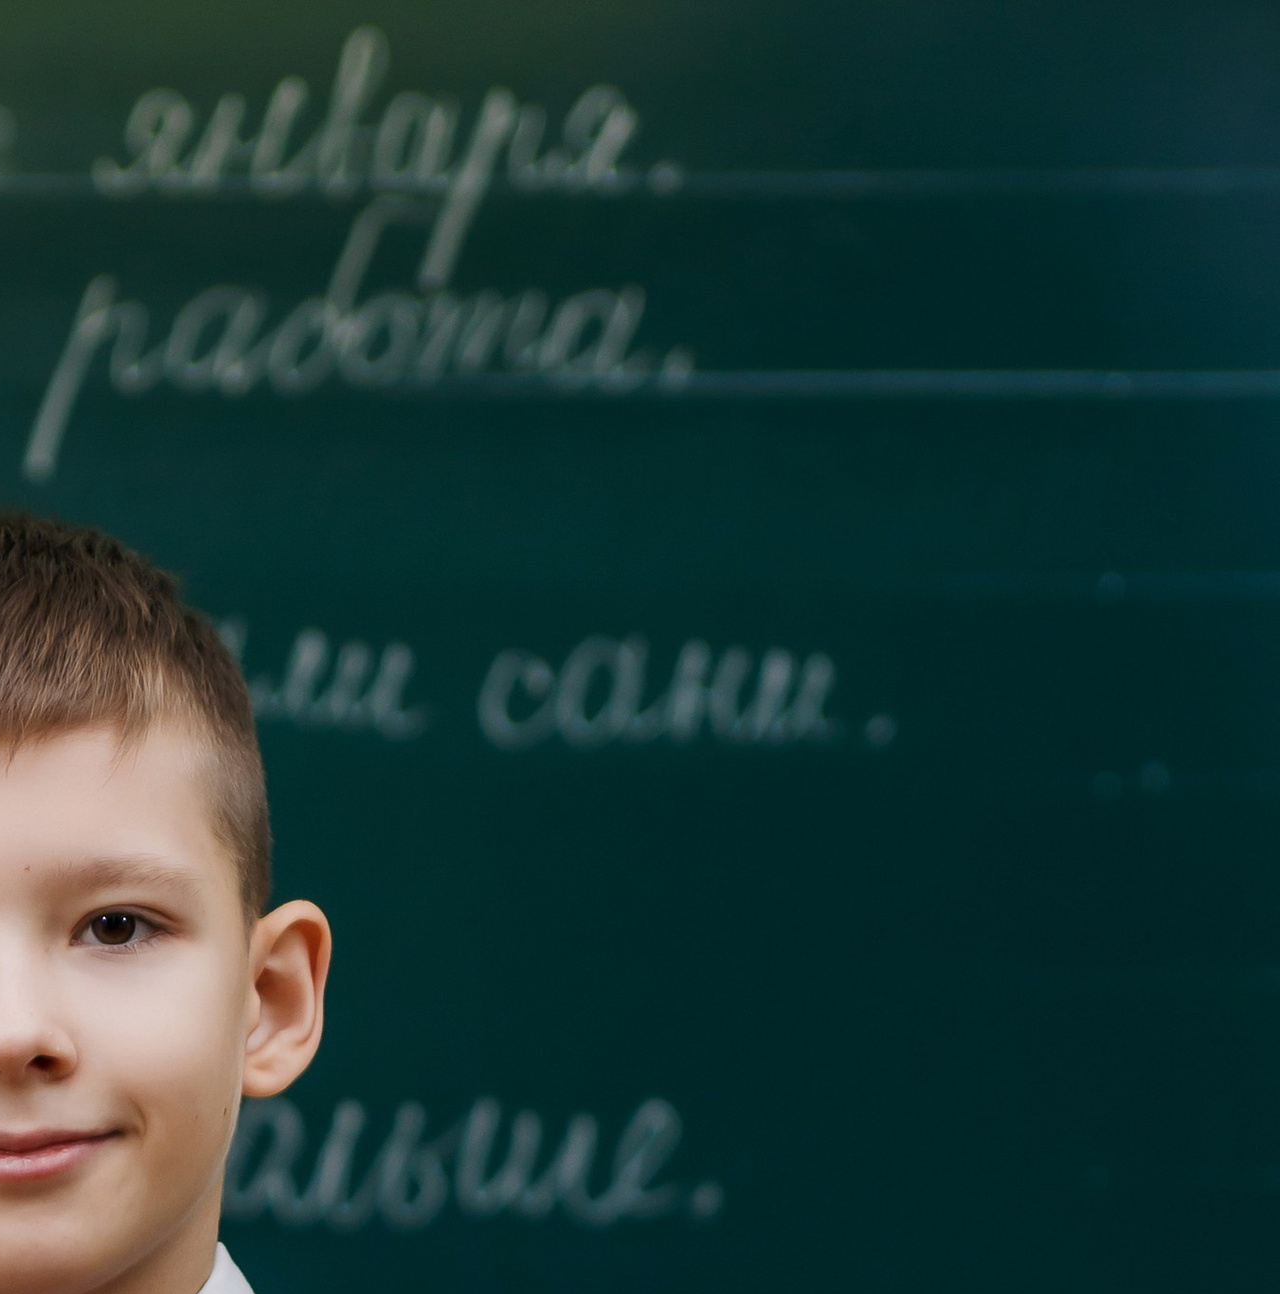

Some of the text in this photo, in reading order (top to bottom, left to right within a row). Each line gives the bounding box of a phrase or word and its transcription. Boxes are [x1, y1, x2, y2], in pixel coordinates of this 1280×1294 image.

[92, 24, 684, 292] января.
[22, 196, 696, 478] работа.
[476, 634, 898, 748] сани.
[223, 1096, 724, 1230] альше.
